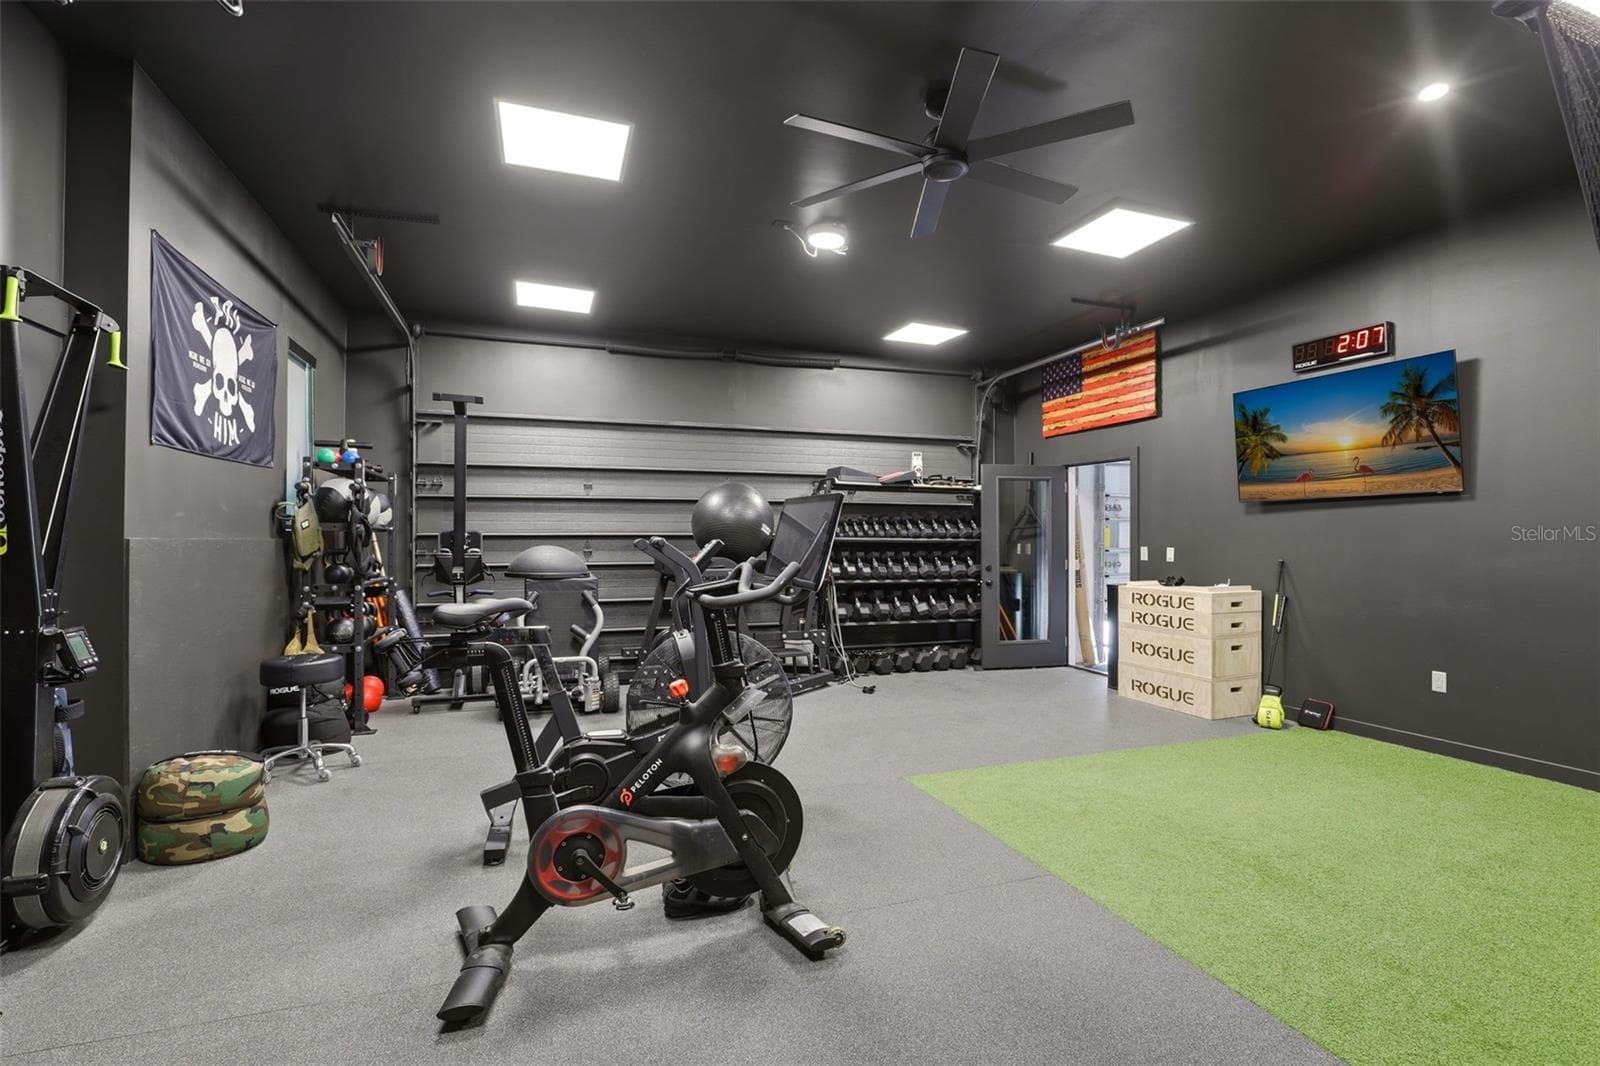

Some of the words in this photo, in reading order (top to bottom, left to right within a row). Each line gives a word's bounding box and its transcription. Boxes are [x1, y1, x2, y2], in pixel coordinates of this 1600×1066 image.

[1337, 326, 1384, 353] 2:07
[1295, 360, 1317, 369] ROGUE
[214, 411, 240, 446] HIM
[1131, 592, 1195, 611] ROGUE
[1131, 611, 1195, 631] ROGUE
[1131, 641, 1195, 664] ROGUE
[269, 685, 300, 695] ROGUE
[1131, 679, 1194, 706] ROGUE
[630, 758, 663, 793] PELOTON
